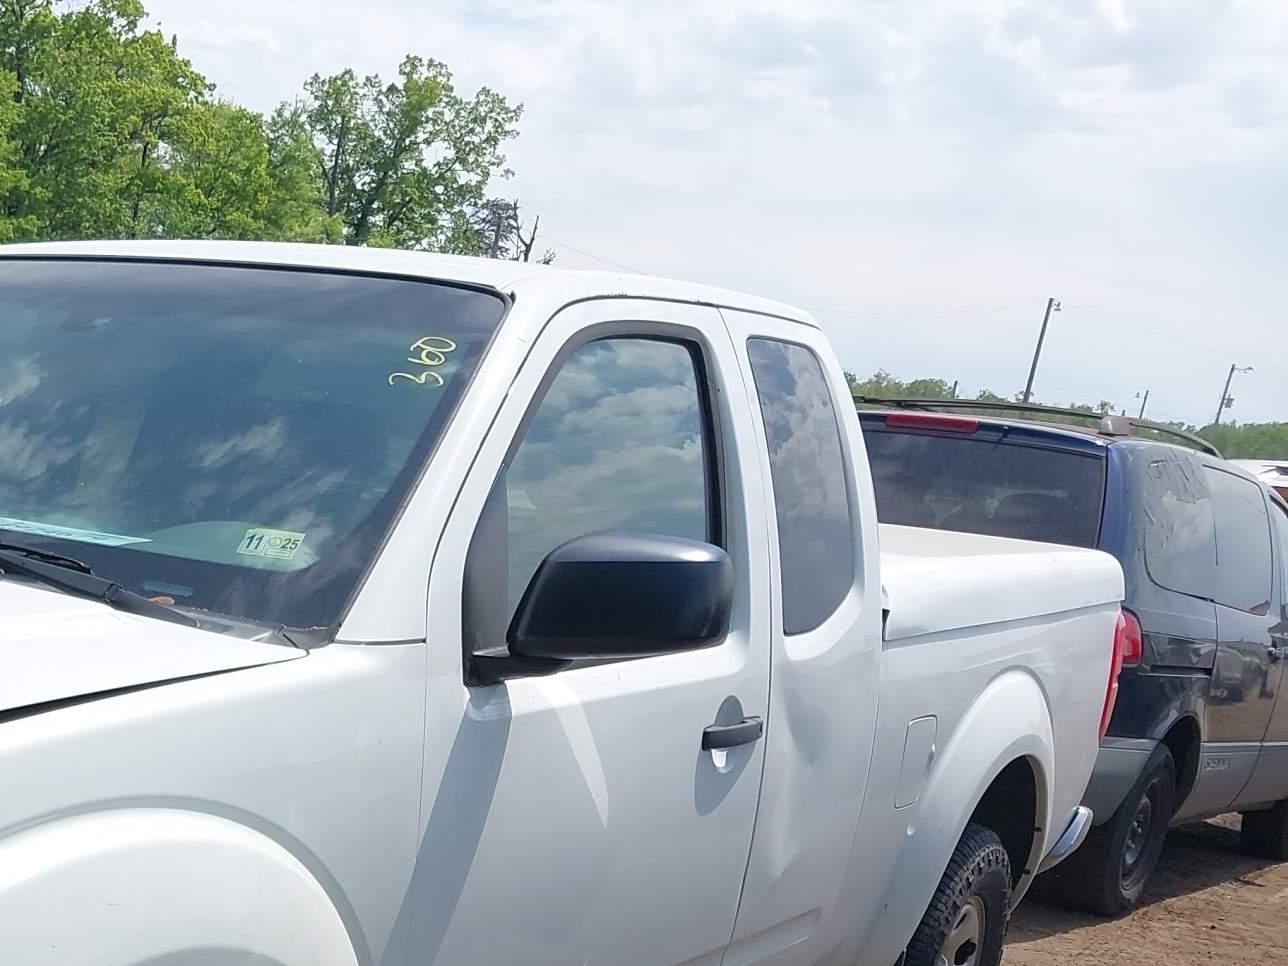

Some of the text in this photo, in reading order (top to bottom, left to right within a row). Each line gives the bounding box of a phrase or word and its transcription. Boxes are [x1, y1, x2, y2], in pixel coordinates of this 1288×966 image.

[388, 336, 457, 388] 360
[245, 534, 301, 551] 11 25
